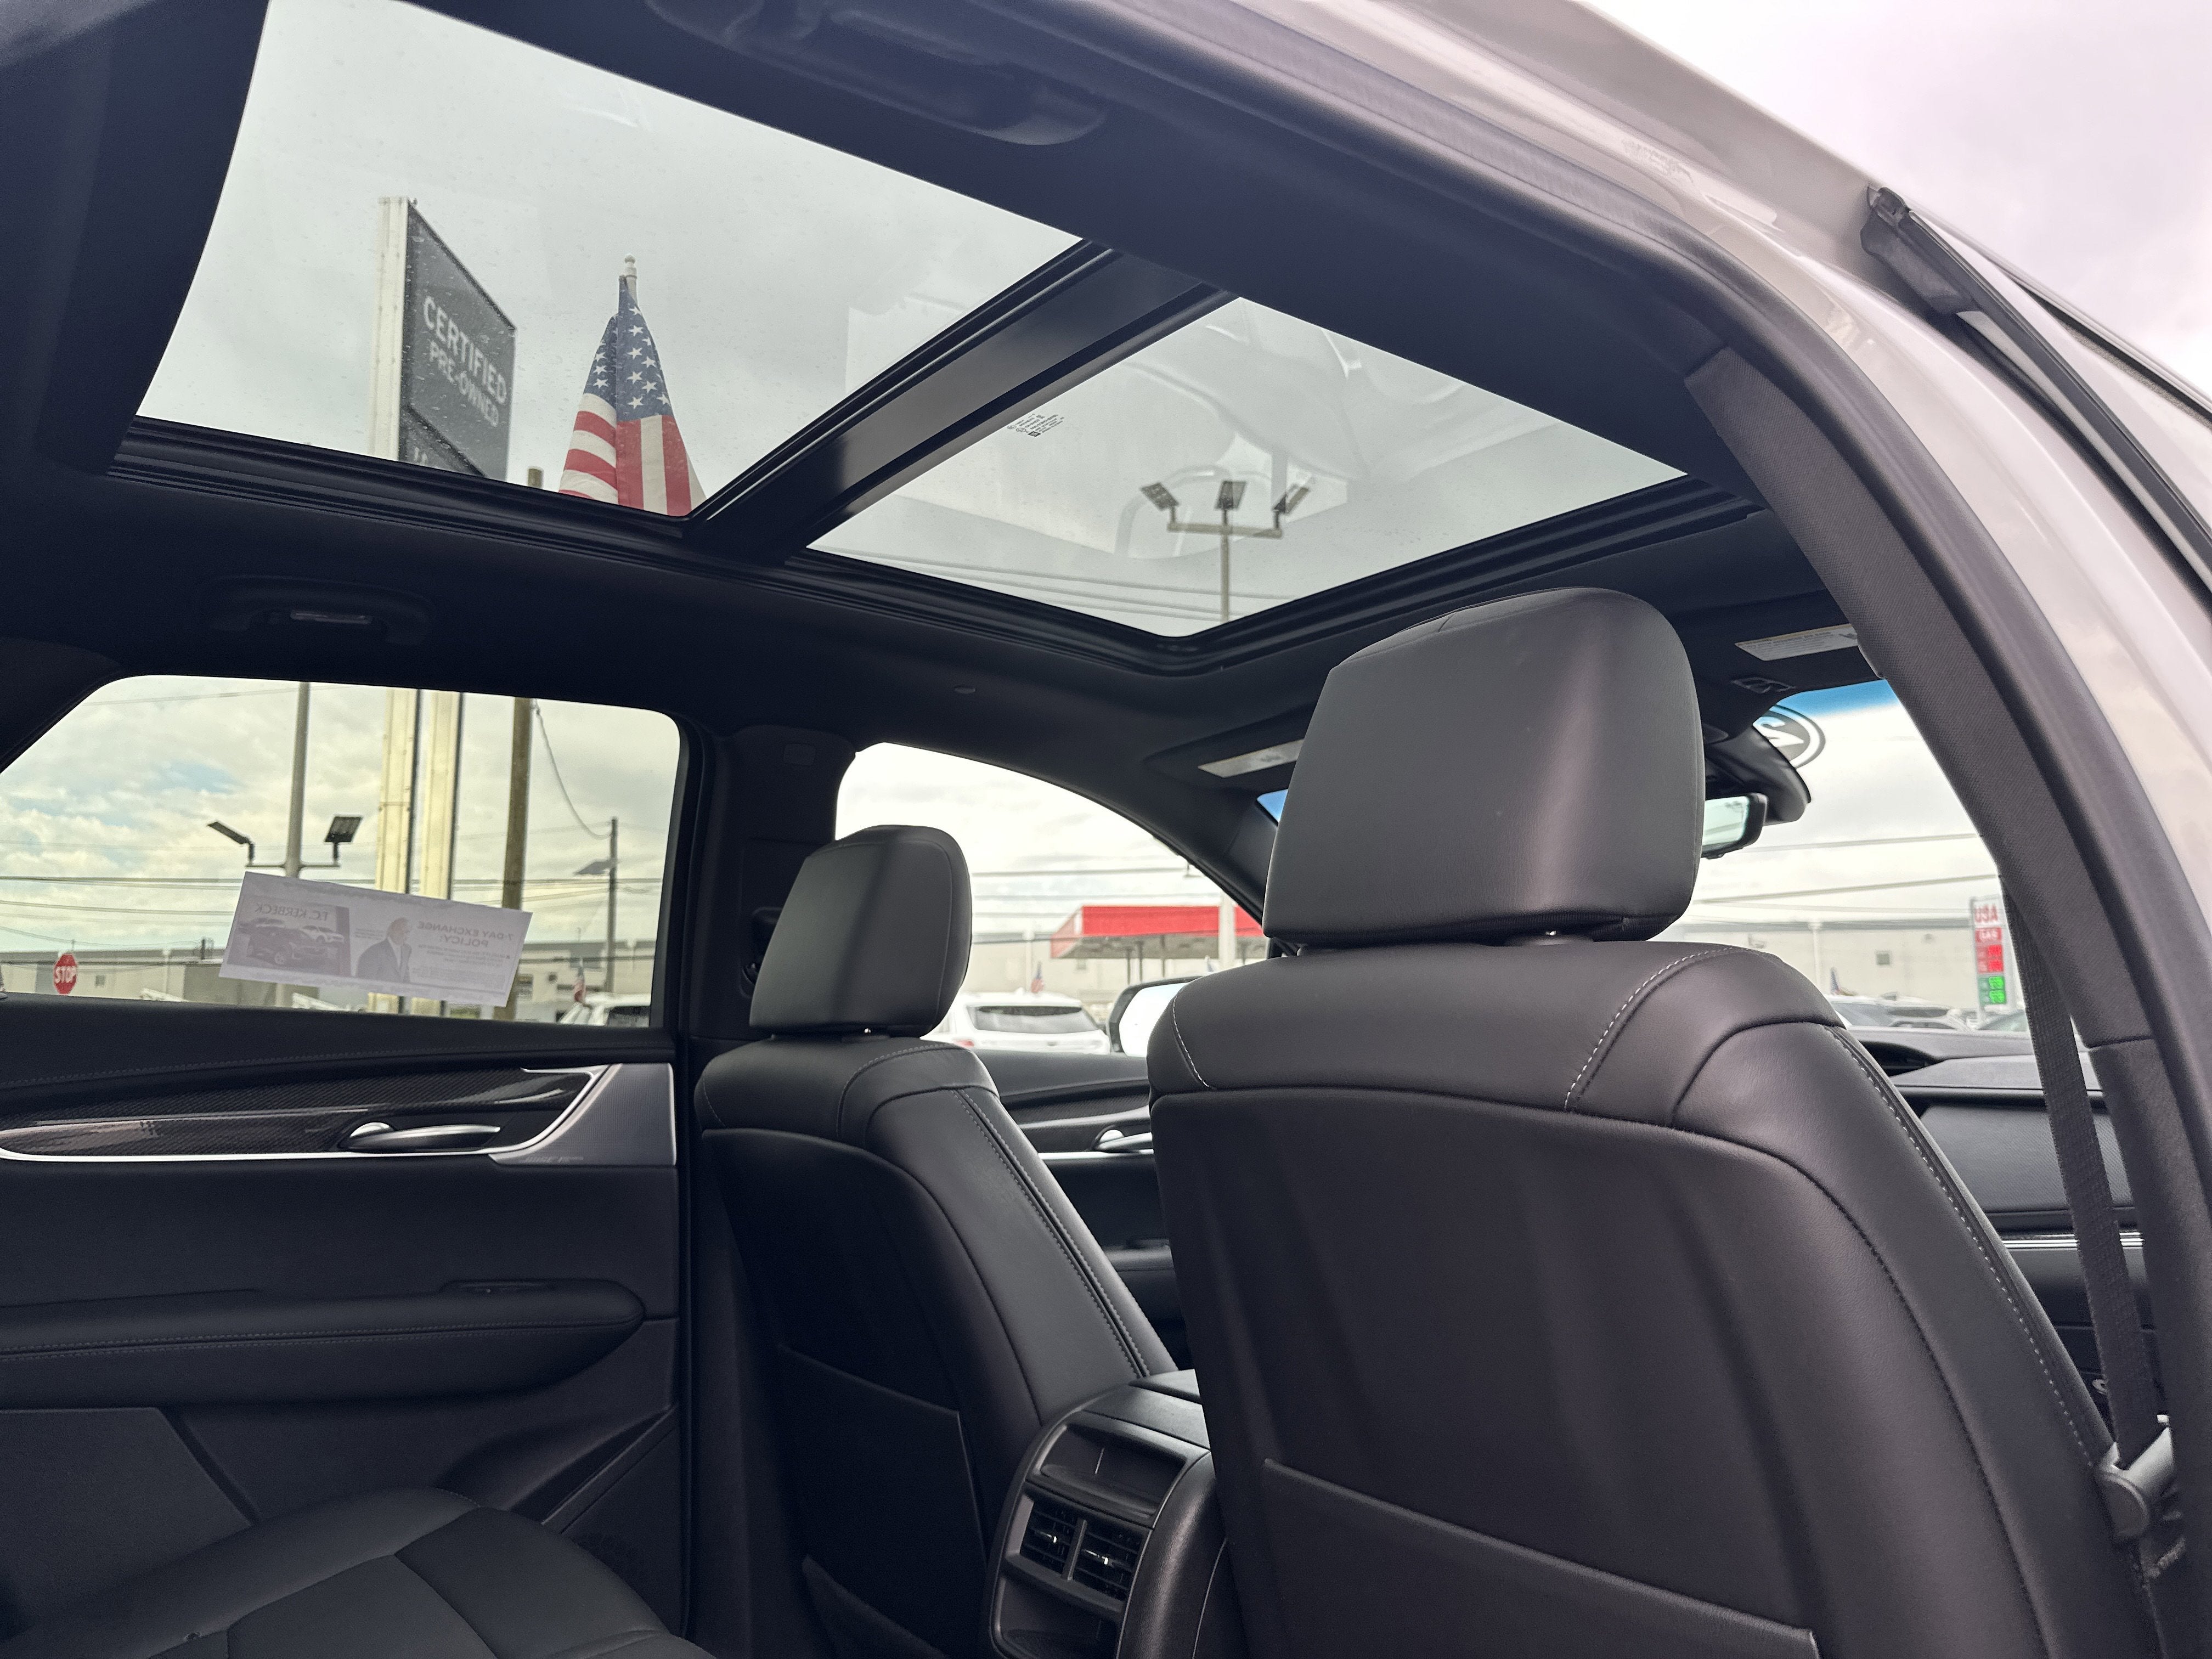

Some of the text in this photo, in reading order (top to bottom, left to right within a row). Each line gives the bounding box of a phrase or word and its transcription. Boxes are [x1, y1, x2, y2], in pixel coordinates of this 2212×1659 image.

[423, 296, 507, 405] CERTIFIED
[429, 340, 499, 427] PRE-OWNED
[1975, 904, 1998, 923] USA
[55, 966, 76, 984] STOP
